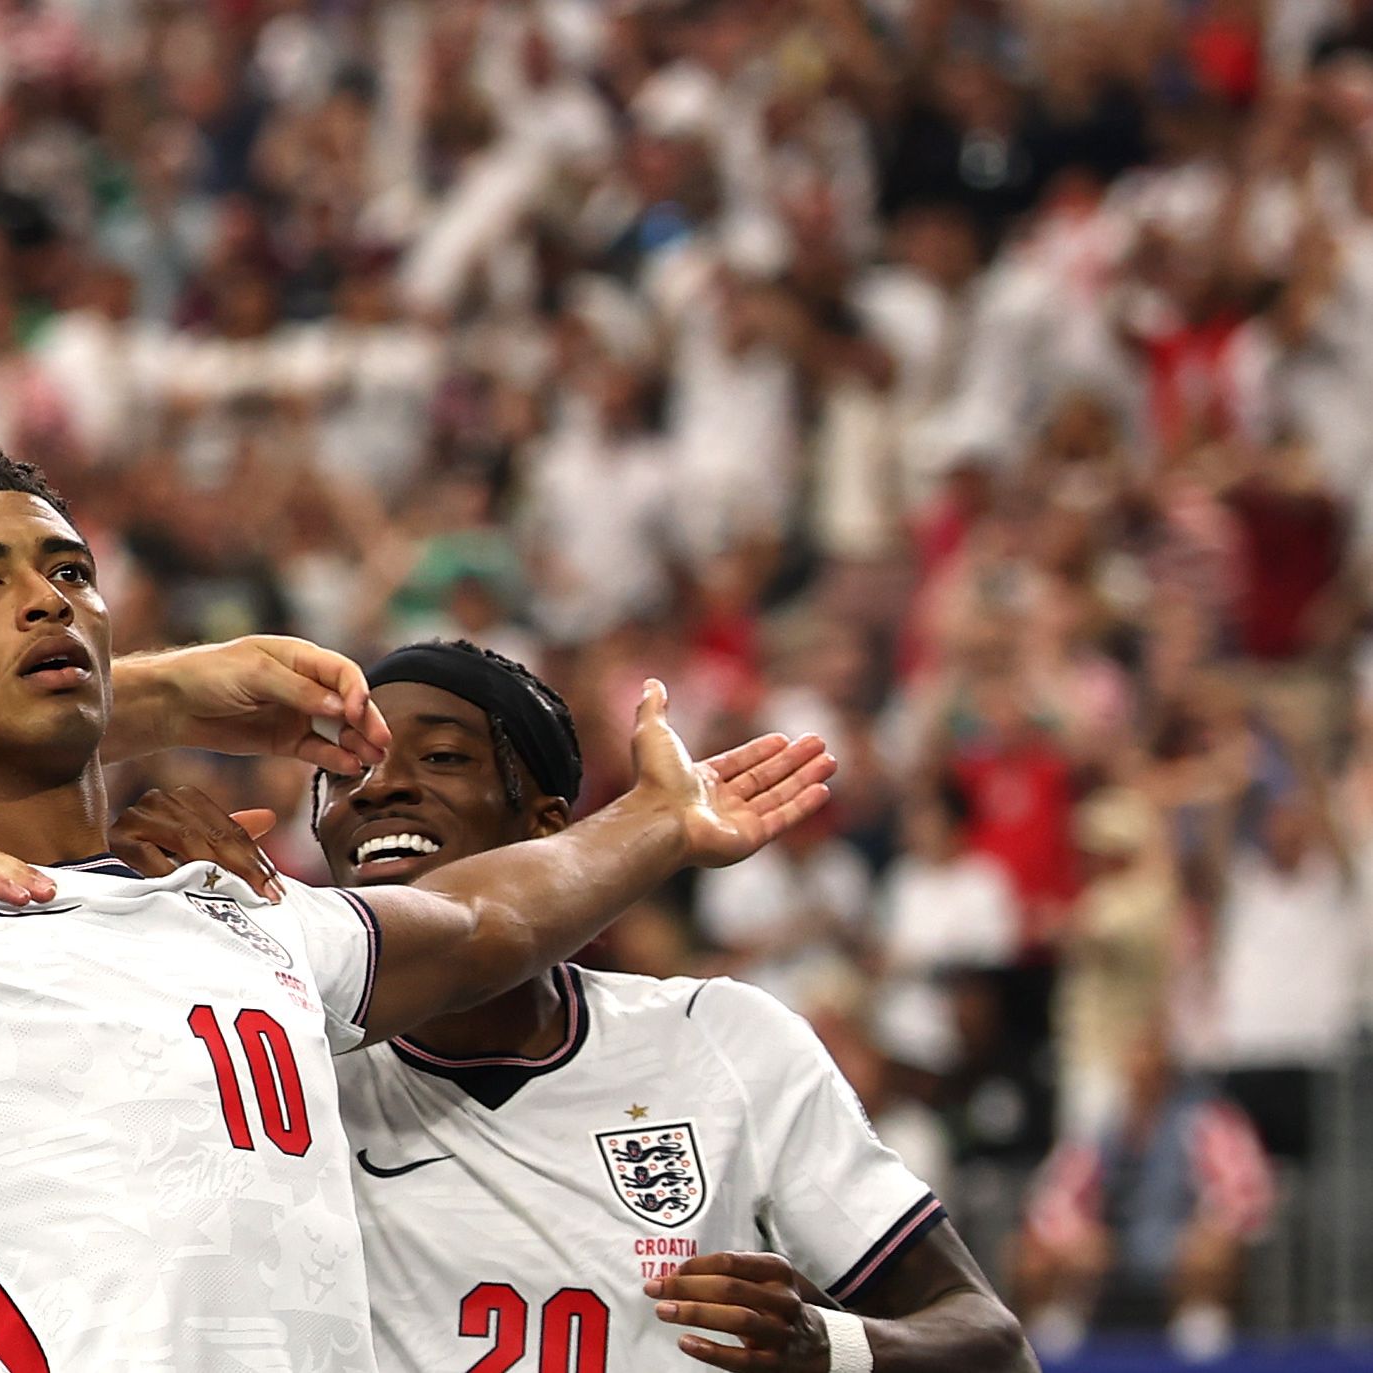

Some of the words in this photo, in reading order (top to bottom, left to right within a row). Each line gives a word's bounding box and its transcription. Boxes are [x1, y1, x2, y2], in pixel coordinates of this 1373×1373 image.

[187, 1004, 312, 1157] 10
[635, 1238, 697, 1257] CROATIA
[459, 1282, 609, 1373] 20
